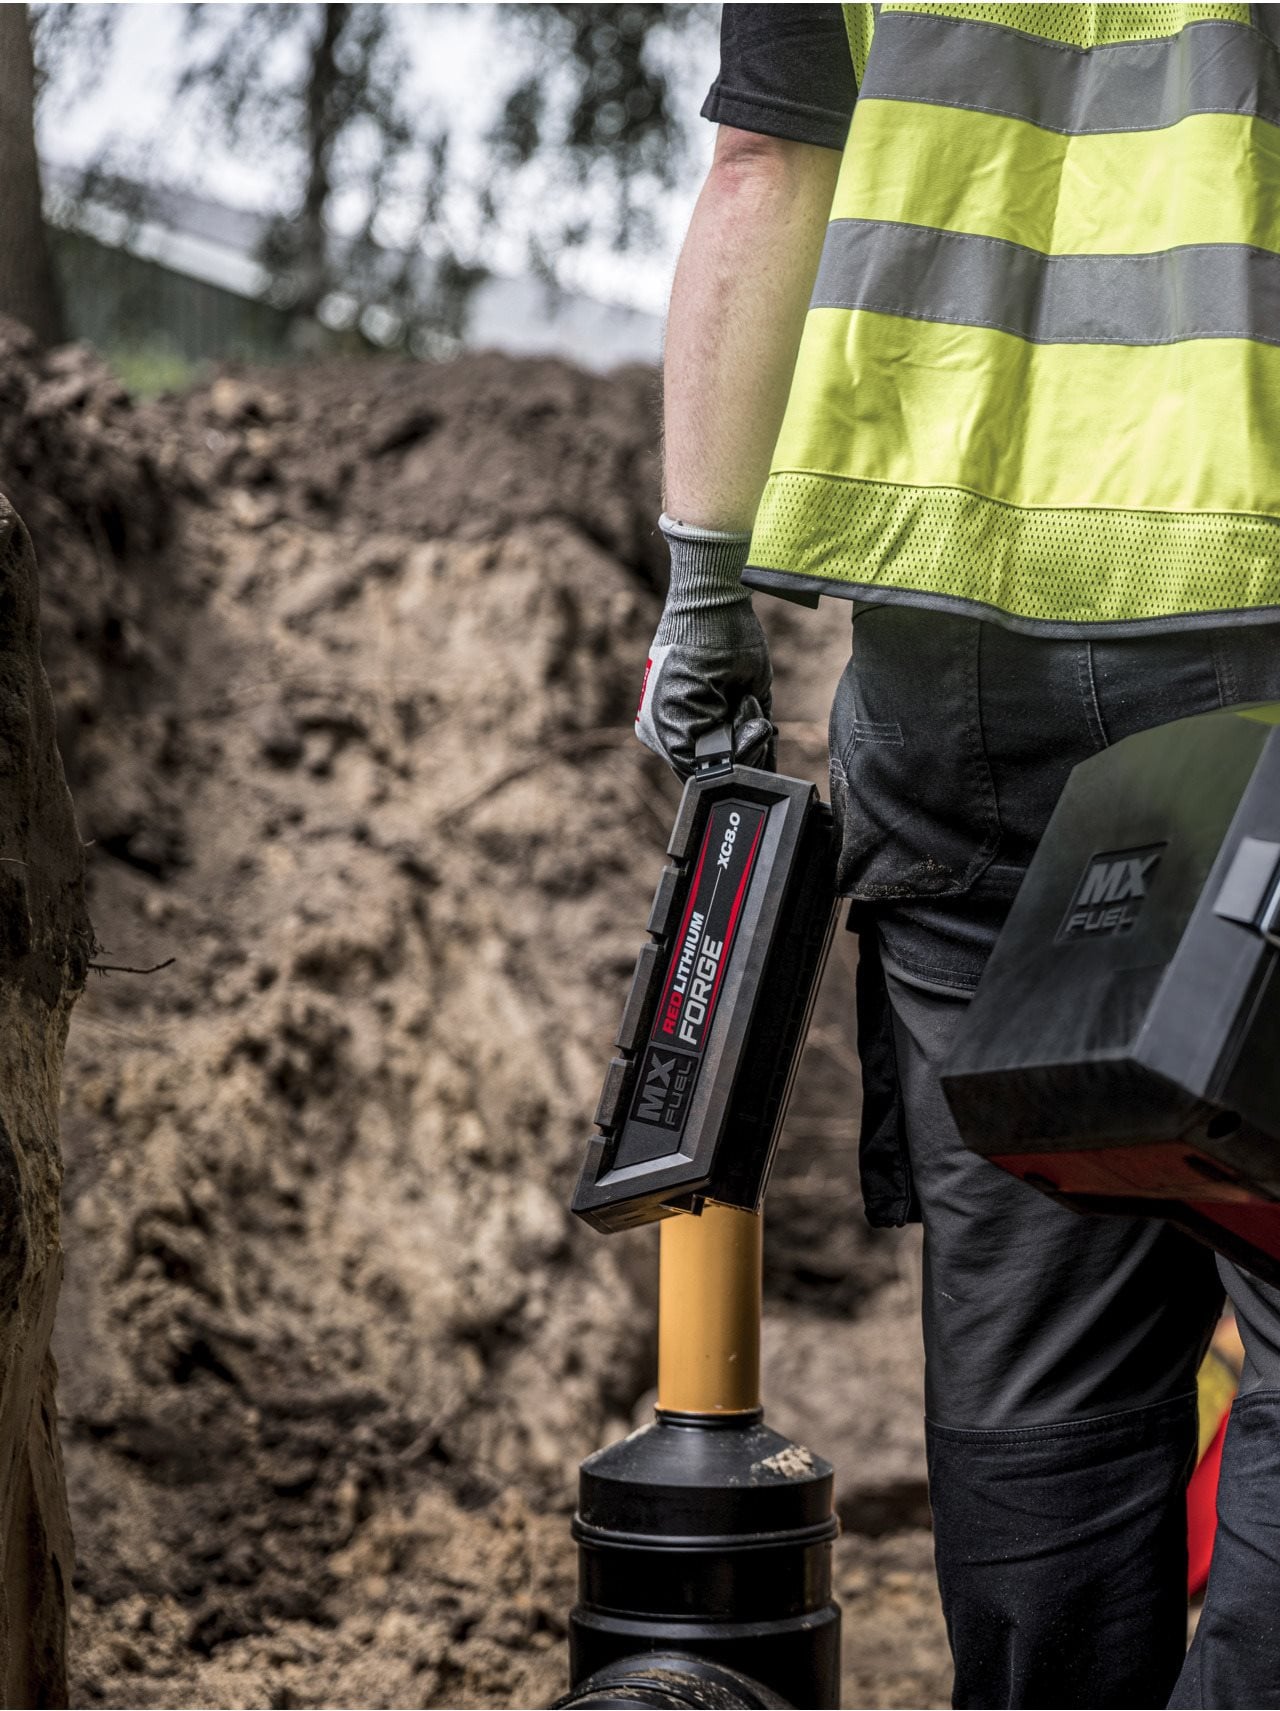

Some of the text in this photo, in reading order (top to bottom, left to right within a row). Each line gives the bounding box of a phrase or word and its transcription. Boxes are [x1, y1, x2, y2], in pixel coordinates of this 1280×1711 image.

[717, 811, 741, 870] XC8.0
[1078, 853, 1160, 906] MX
[1065, 906, 1134, 932] FUEL
[678, 934, 723, 1045] FORGE
[636, 1054, 677, 1123] MX
[665, 1060, 694, 1128] FUEL
